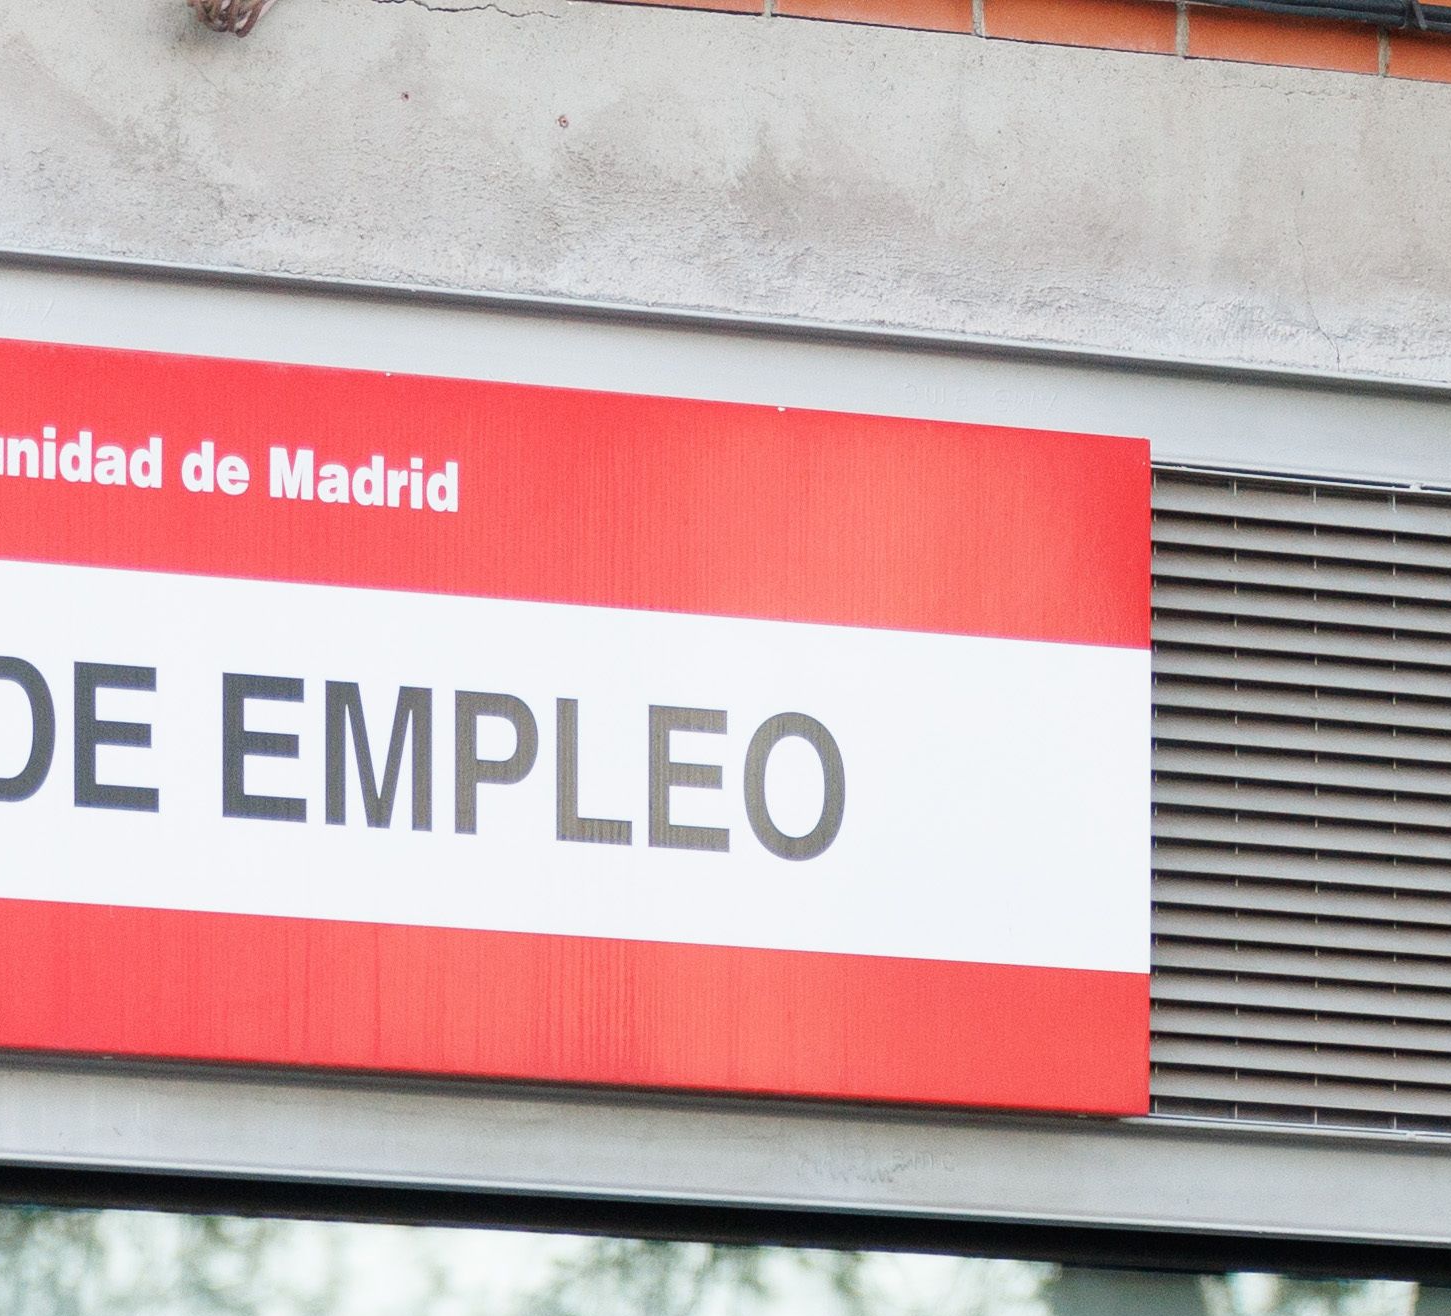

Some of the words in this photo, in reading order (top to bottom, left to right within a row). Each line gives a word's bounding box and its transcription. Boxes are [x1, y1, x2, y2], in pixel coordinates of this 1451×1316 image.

[181, 437, 250, 498] de
[268, 445, 459, 514] Madrid
[221, 671, 847, 862] EMPLEO
